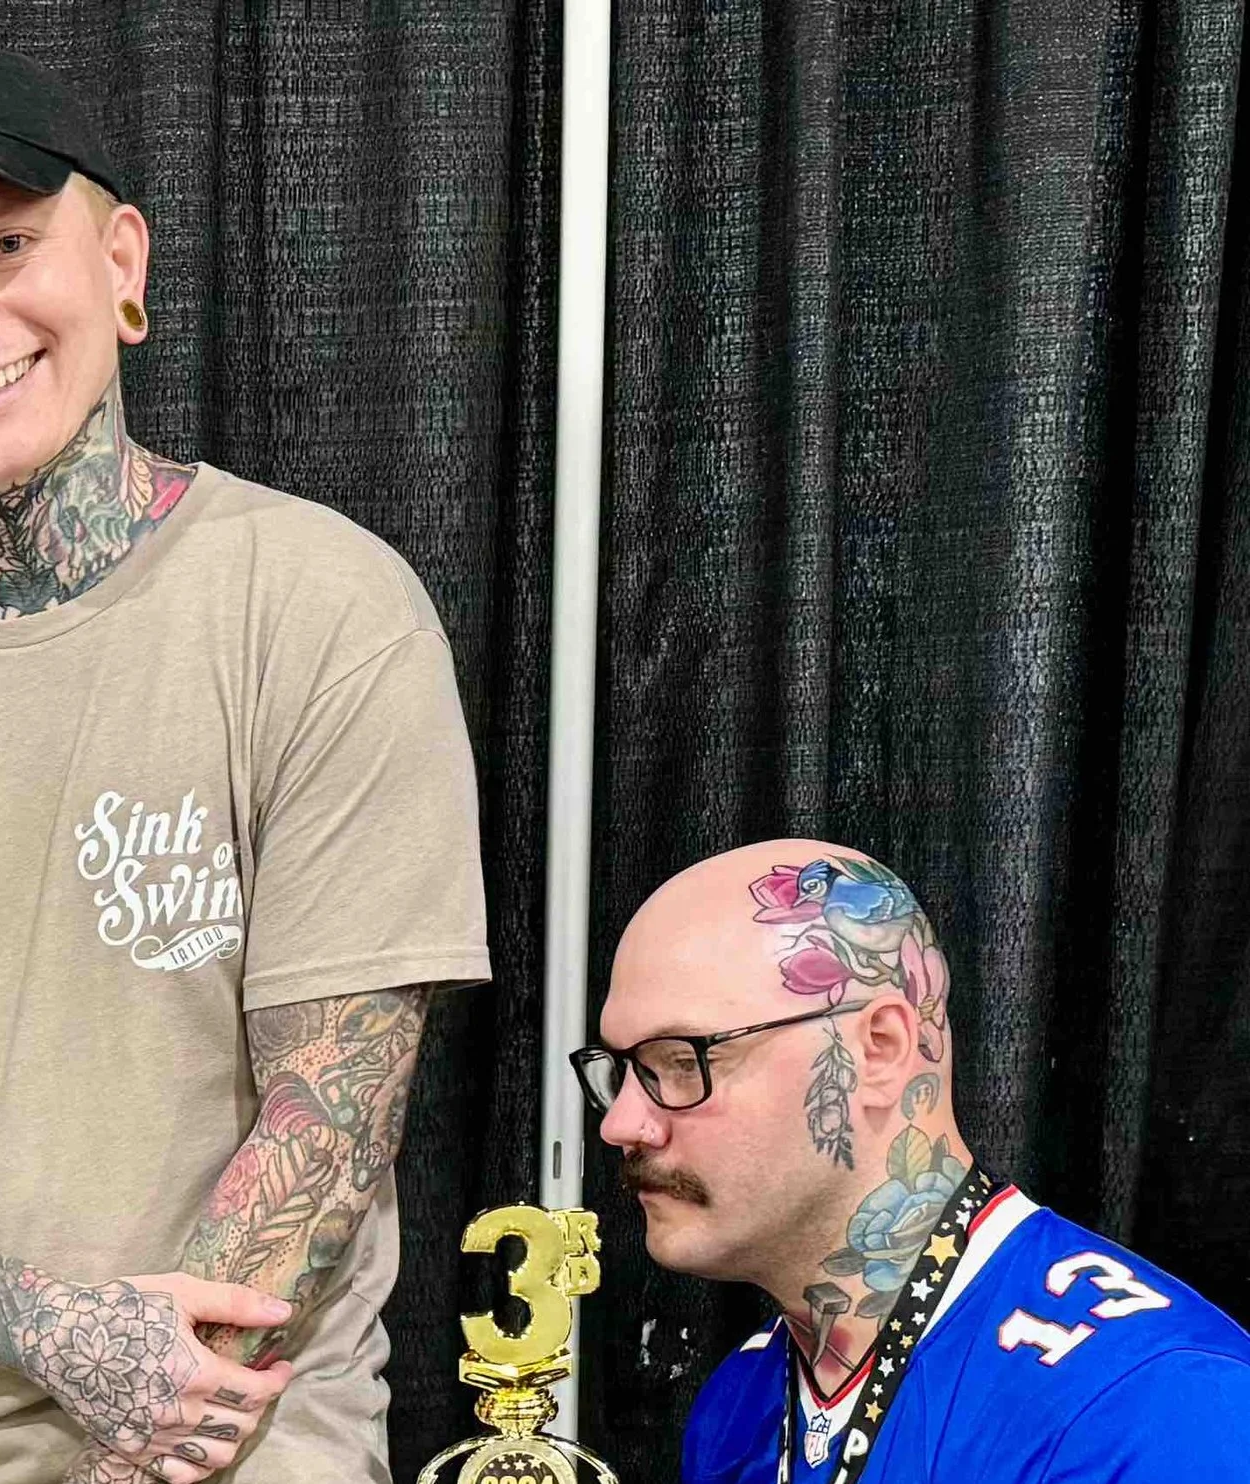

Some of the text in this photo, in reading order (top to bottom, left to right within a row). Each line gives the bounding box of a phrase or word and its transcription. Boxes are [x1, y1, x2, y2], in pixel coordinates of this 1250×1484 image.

[74, 787, 235, 880] Sink o
[170, 927, 224, 966] TATTOO
[996, 1249, 1173, 1368] 13
